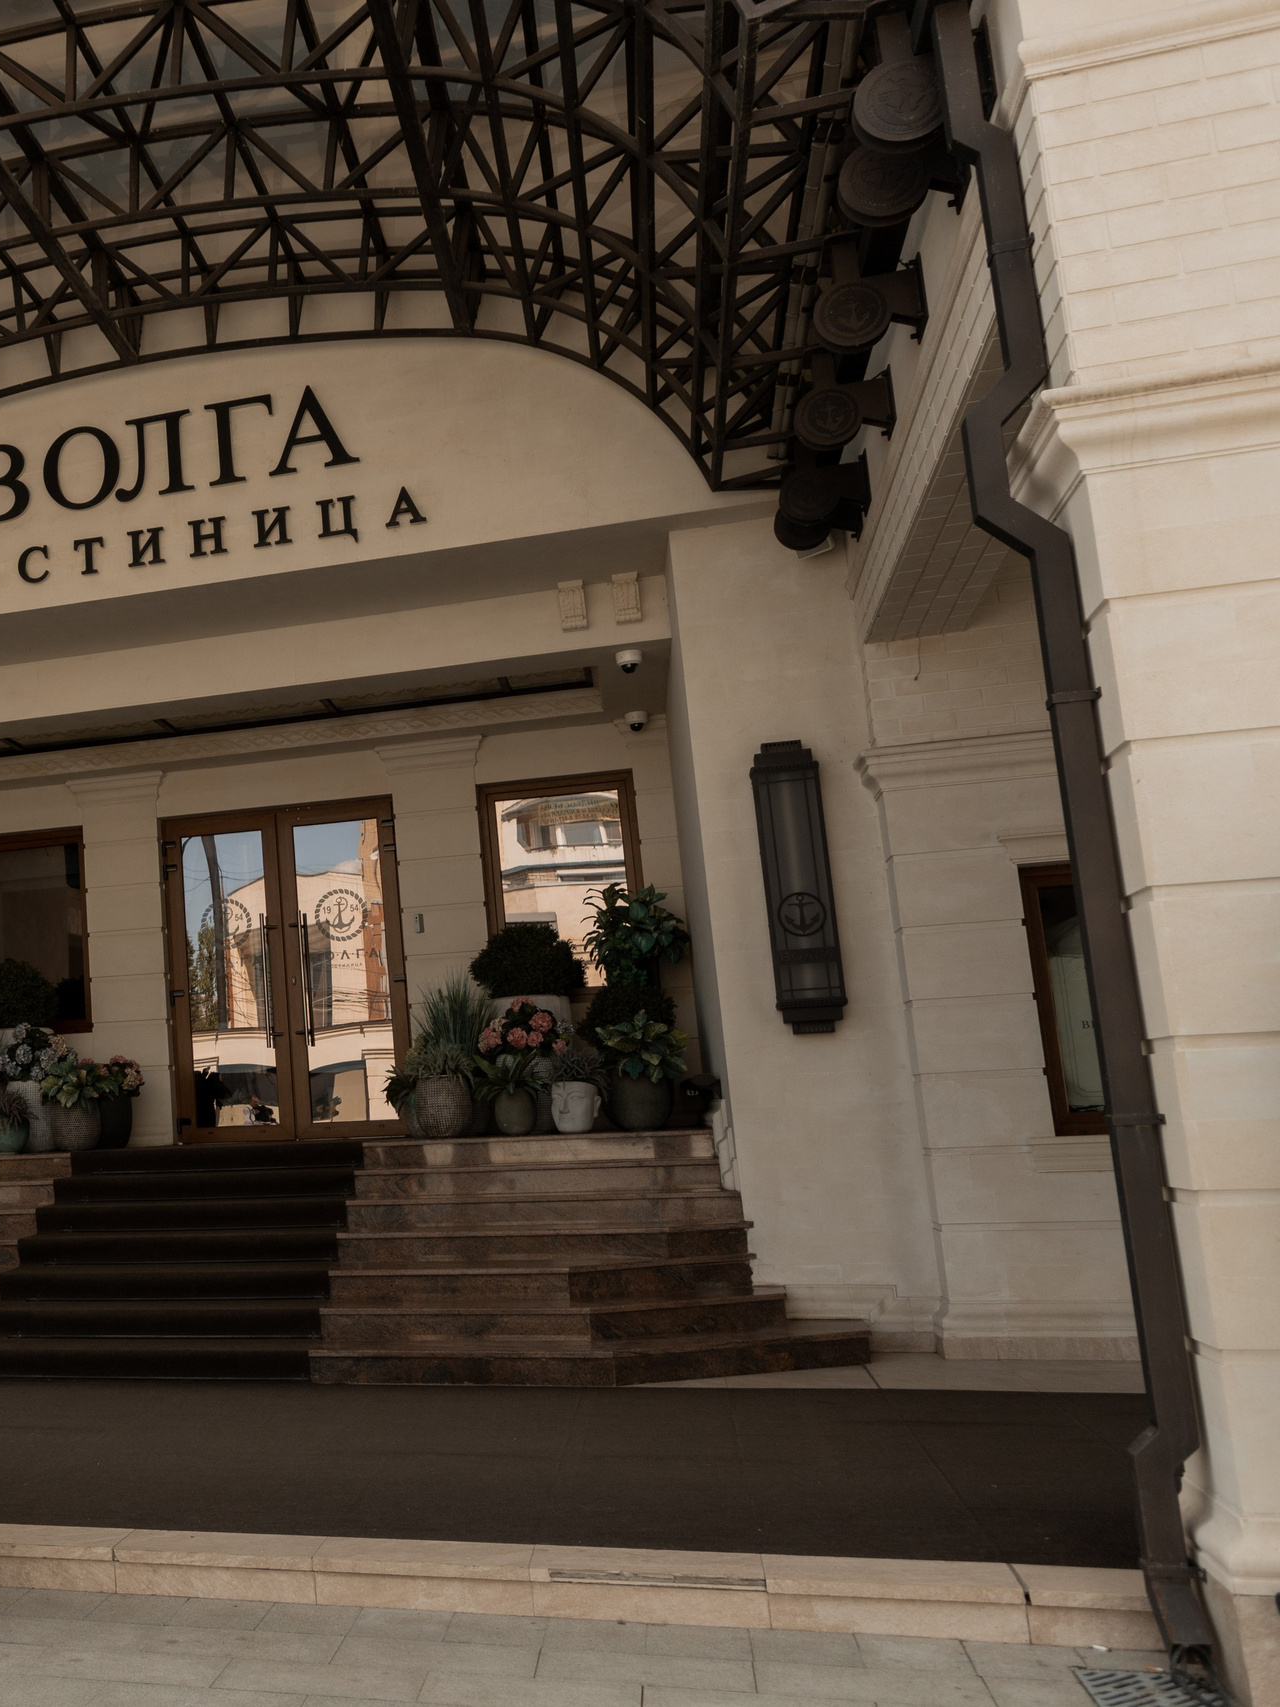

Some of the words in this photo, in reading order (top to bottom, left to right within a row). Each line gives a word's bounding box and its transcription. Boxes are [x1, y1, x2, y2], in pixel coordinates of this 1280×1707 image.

[322, 906, 332, 914] 19
[349, 904, 359, 912] 54
[234, 913, 243, 921] 54
